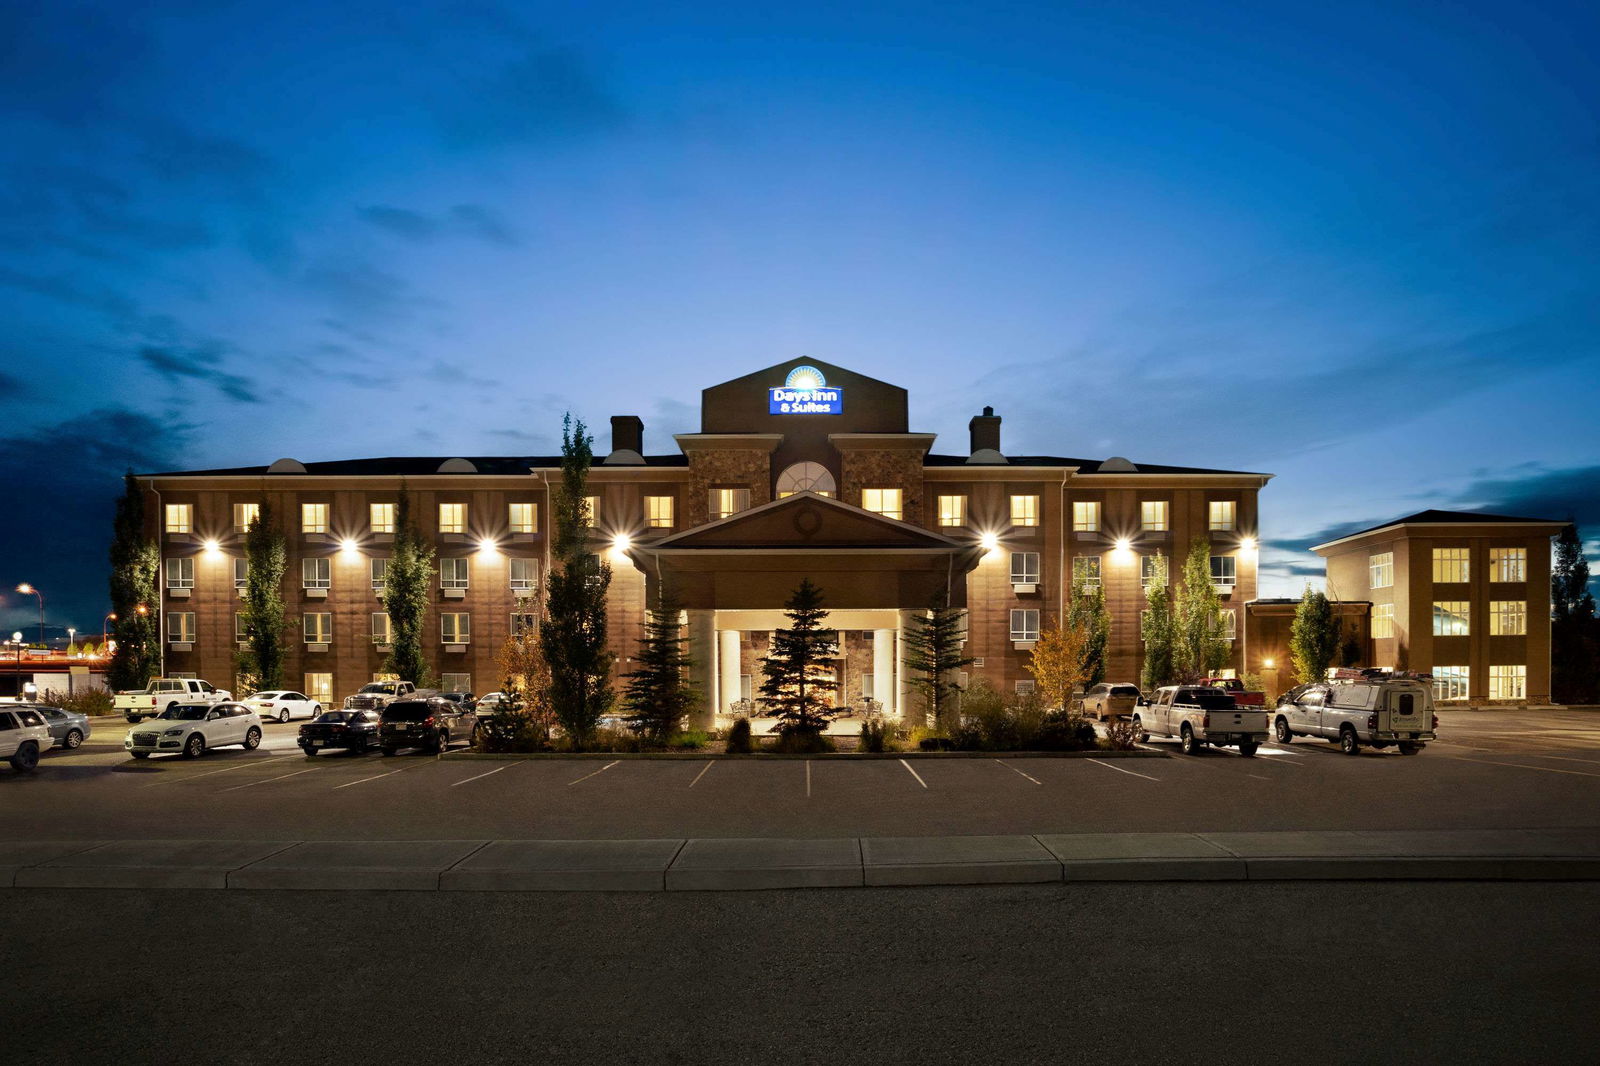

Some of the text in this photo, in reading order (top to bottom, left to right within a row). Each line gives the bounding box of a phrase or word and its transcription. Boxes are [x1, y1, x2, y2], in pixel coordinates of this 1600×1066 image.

[773, 390, 838, 403] Days Inn
[780, 401, 831, 413] & Suites
